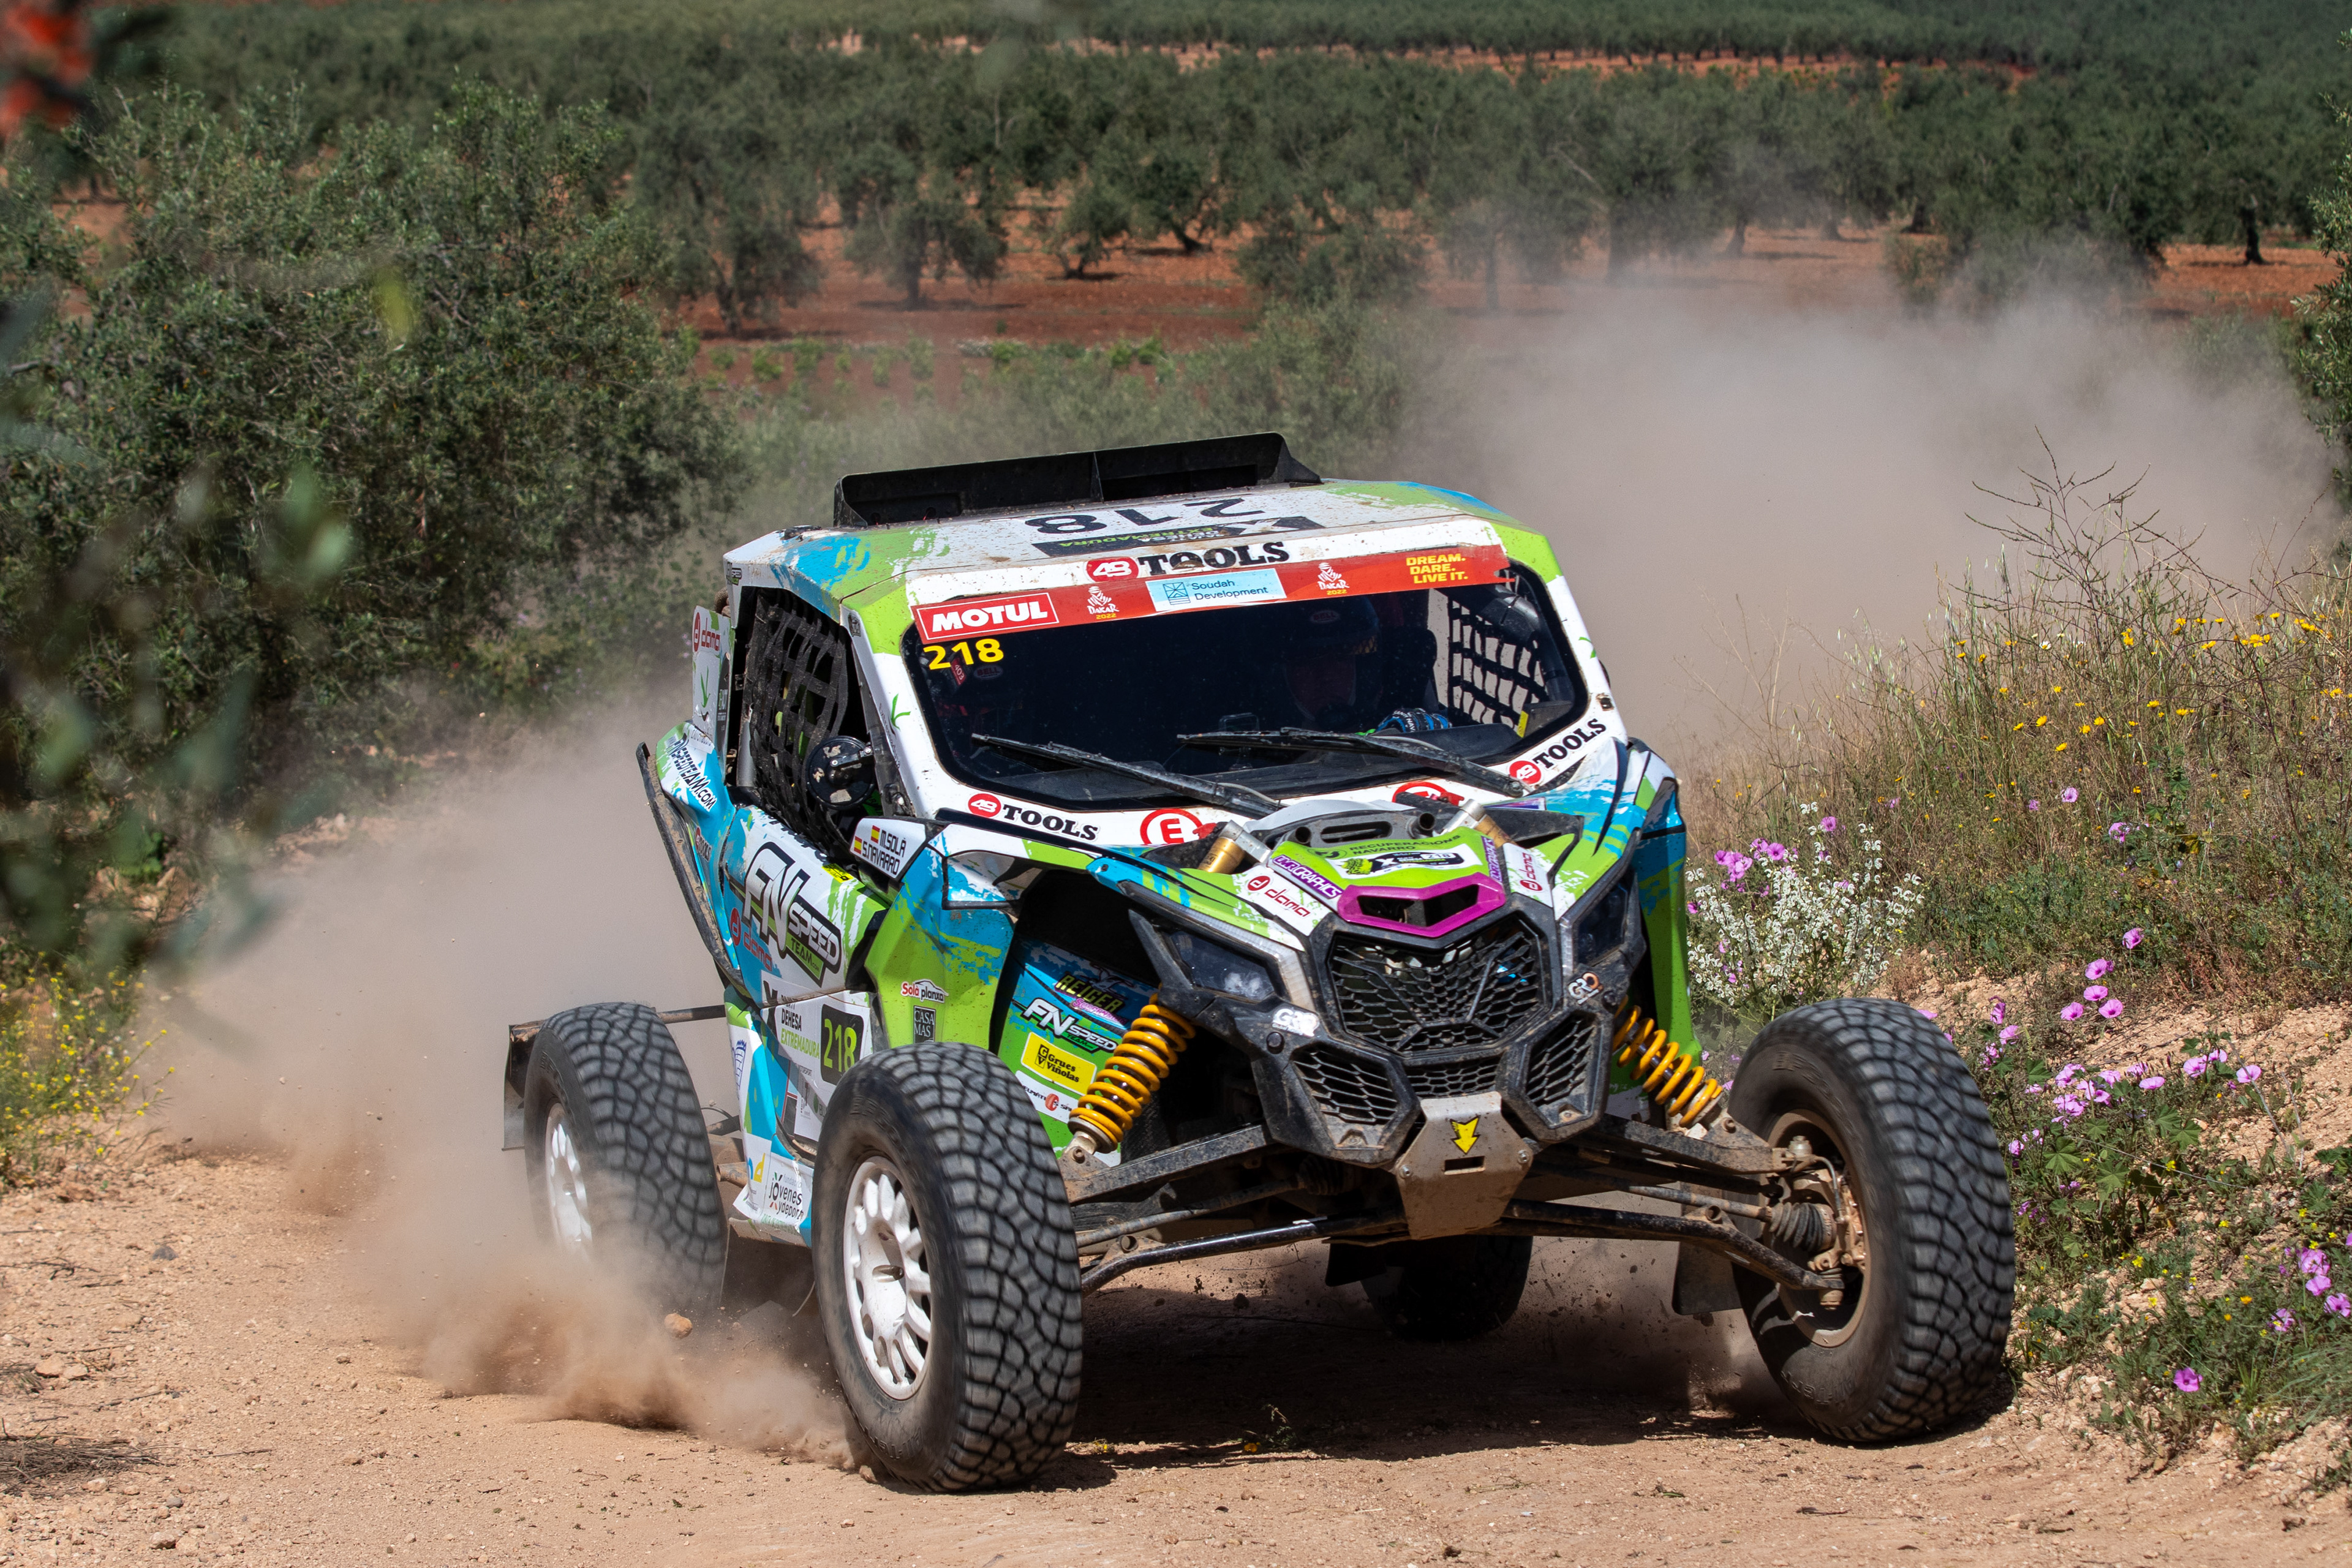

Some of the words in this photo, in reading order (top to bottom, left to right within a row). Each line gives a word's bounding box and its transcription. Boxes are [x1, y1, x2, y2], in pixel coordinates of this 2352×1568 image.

[1025, 498, 1265, 534] 218
[1059, 527, 1213, 547] EXTREMADURA
[1138, 541, 1291, 576] TOOLS
[1406, 553, 1466, 566] DREAM.
[1409, 562, 1455, 575] DARE.
[1191, 579, 1235, 591] Soudah
[1317, 580, 1350, 590] DAKAR
[1413, 572, 1447, 584] LIVE
[1450, 571, 1469, 581] IT.
[1194, 586, 1269, 601] Development
[932, 601, 1048, 632] MOTUL
[1088, 605, 1119, 614] DAKAR
[923, 639, 1004, 670] 218
[1406, 718, 1415, 732] NAV
[1534, 718, 1607, 769] TOOLS
[1003, 804, 1098, 840] TOOLS
[1349, 835, 1461, 850] RECUPERACIONS
[1353, 846, 1415, 854] NAVARRO
[862, 841, 900, 875] S.NAVARRO
[788, 902, 840, 965] SPEED
[902, 982, 919, 997] Solà
[921, 986, 943, 1001] planxa
[1055, 976, 1124, 1012] REIGER
[781, 1008, 802, 1031] DEHESA
[914, 1011, 934, 1025] CASA
[914, 1023, 930, 1037] MAS
[1068, 1025, 1117, 1050] SPEED
[781, 1028, 820, 1059] EXTREMADURA
[823, 1019, 857, 1072] 218
[1046, 1063, 1080, 1083] Viñolas
[1048, 1055, 1076, 1072] Grues
